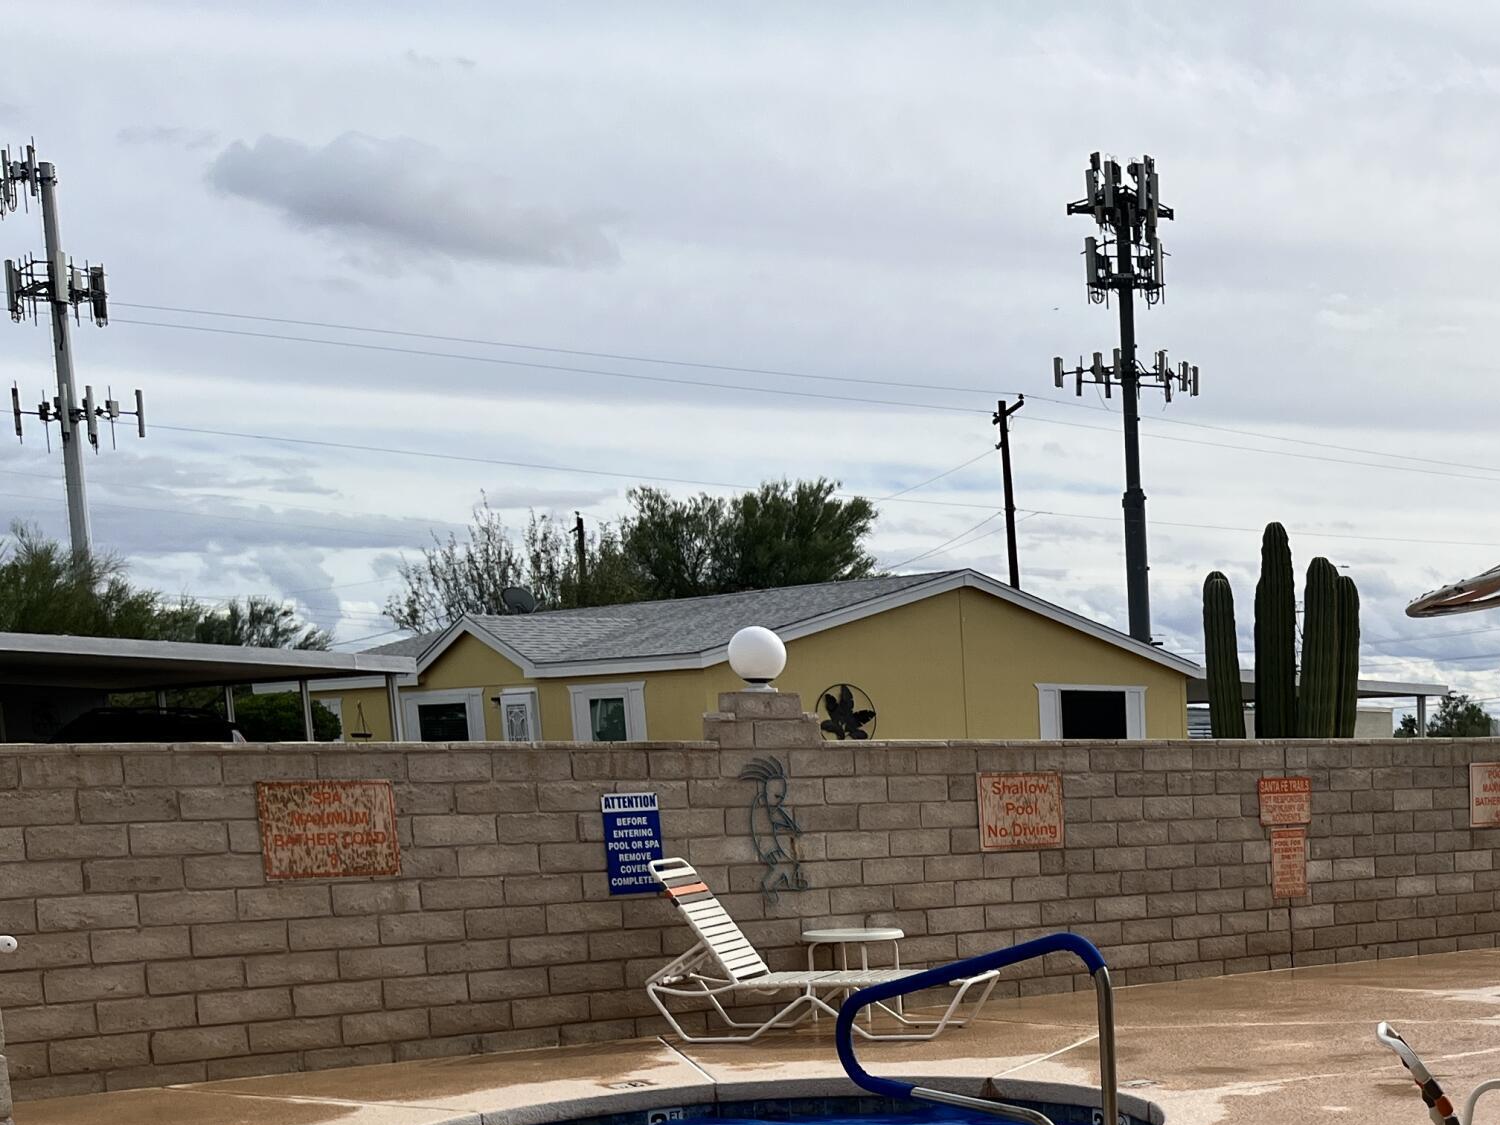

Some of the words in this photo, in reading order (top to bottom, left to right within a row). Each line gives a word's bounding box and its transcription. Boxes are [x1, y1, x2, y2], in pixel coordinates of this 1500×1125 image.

[991, 781, 1049, 795] Shallow
[1260, 781, 1280, 792] SANTA
[1280, 780, 1289, 791] FE
[1289, 780, 1309, 791] TRAILS
[310, 791, 342, 804] SPA
[604, 794, 656, 809] ATTENTION
[1005, 802, 1038, 816] Pool
[291, 811, 369, 826] MAXIMUM
[616, 816, 647, 826] BEFORE
[613, 828, 653, 838] ENTERING
[987, 824, 1008, 838] No
[1012, 822, 1057, 838] Diving
[274, 832, 338, 847] BATHER
[608, 842, 630, 850] POOL
[631, 841, 643, 849] OR
[645, 840, 660, 848] SPA
[619, 852, 651, 862] REMOVE
